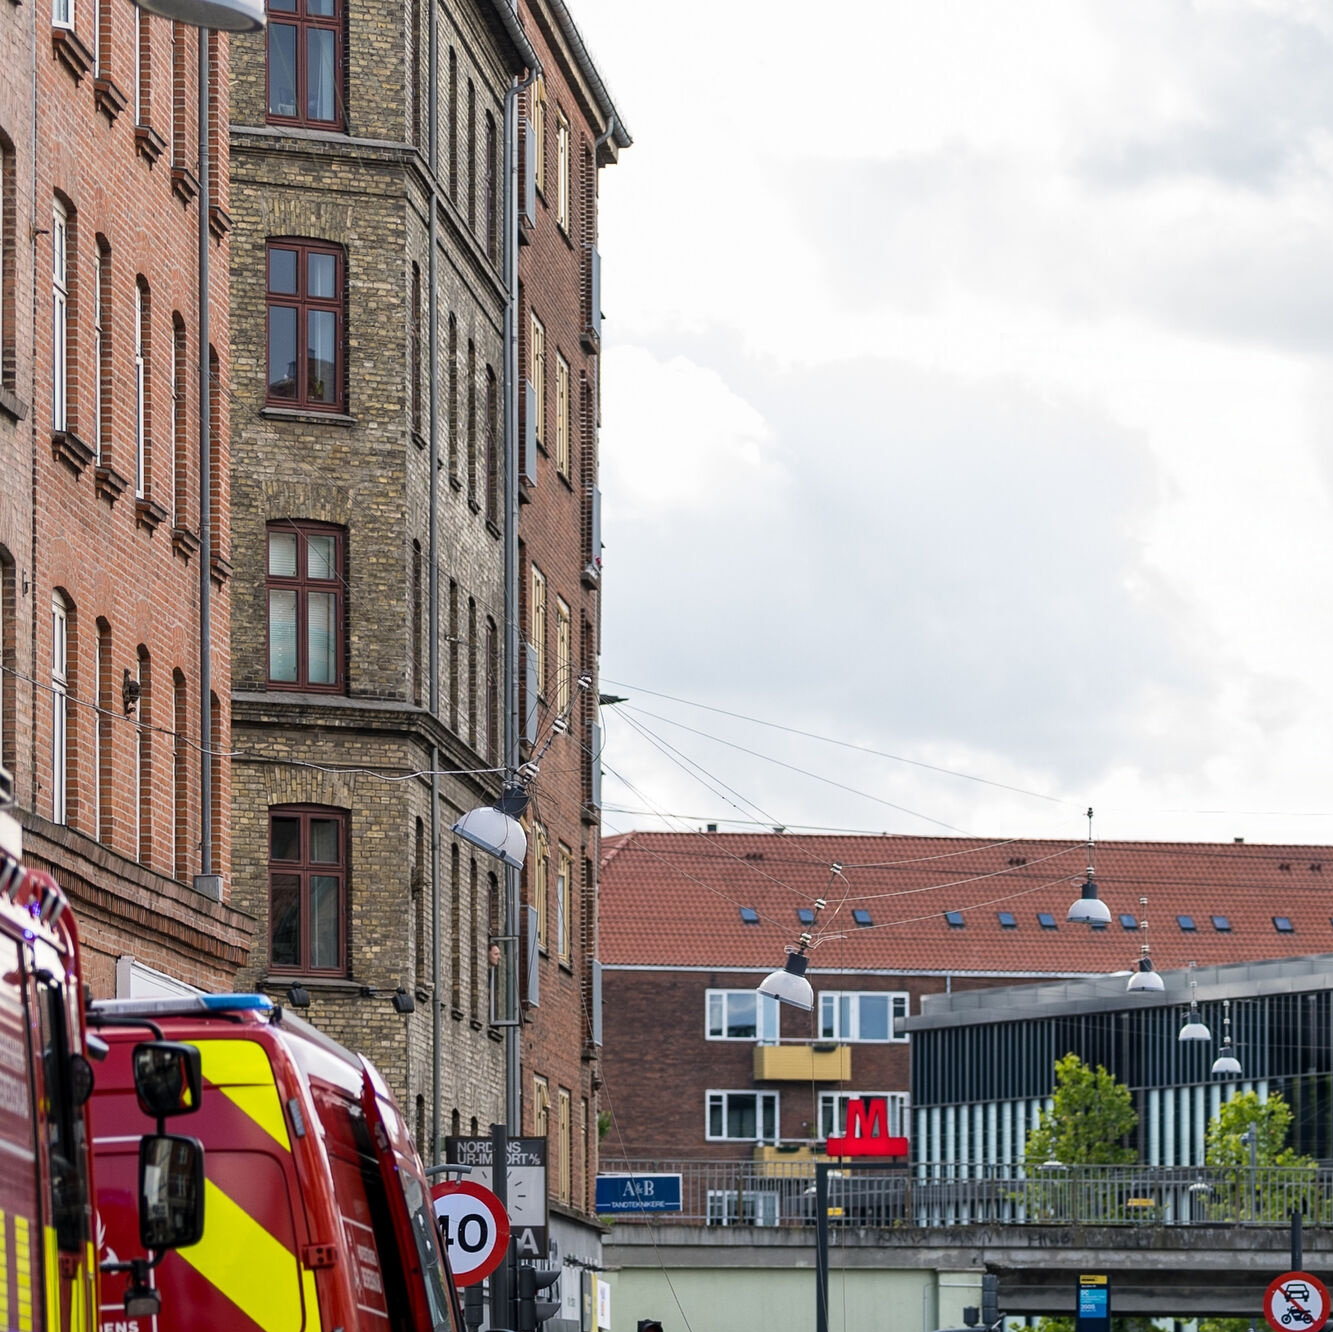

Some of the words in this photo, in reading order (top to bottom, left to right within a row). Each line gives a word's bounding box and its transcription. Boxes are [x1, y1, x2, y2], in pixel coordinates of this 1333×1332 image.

[457, 1141, 522, 1154] NORDNS
[457, 1153, 527, 1165] UR-IMORT
[622, 1180, 655, 1197] A&B
[611, 1201, 665, 1209] TANDTEKNIKERE
[439, 1213, 488, 1253] 40
